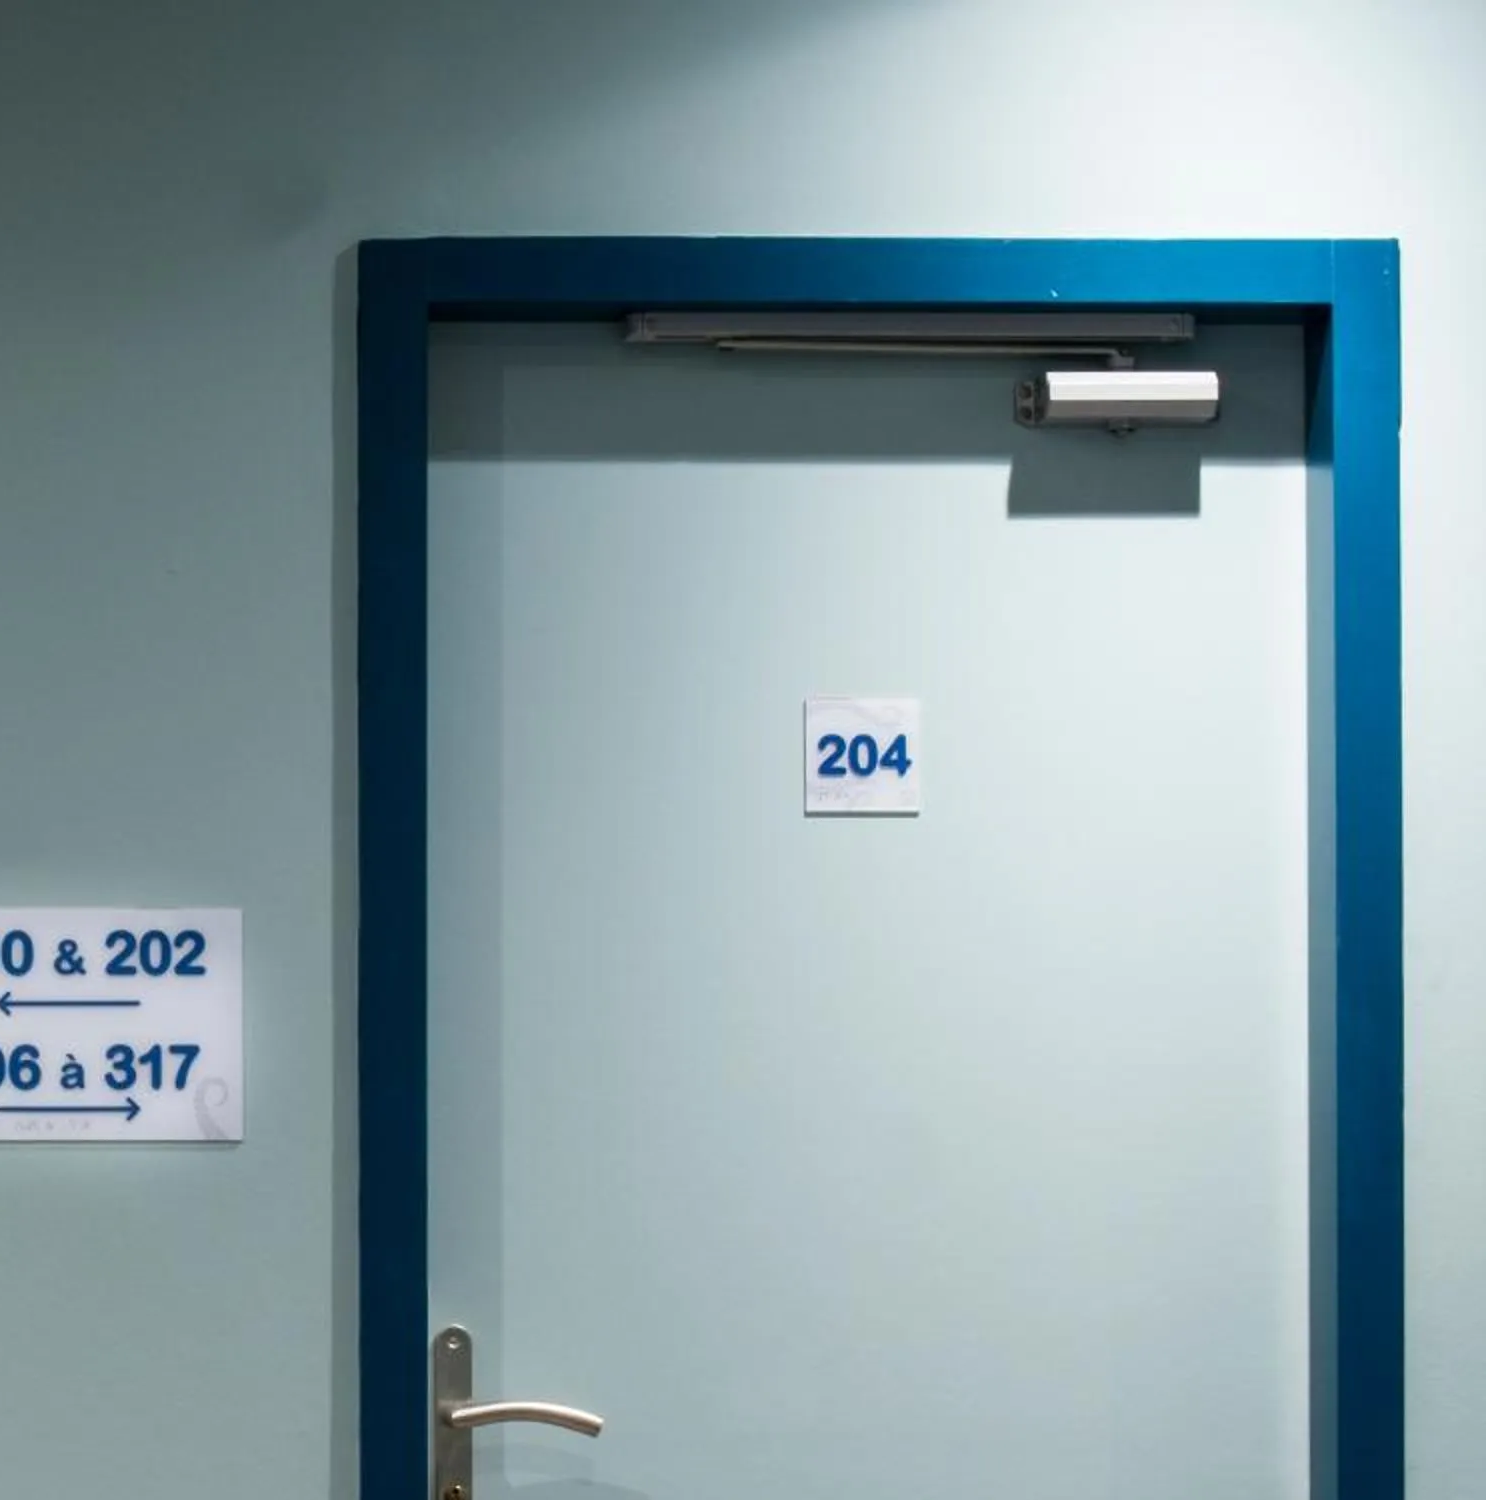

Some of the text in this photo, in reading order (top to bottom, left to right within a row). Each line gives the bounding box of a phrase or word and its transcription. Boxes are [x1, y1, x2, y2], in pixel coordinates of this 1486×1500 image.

[817, 733, 912, 778] 204
[53, 938, 87, 977] &
[104, 928, 207, 978] 202
[59, 1053, 86, 1091] à
[104, 1043, 201, 1092] 317
